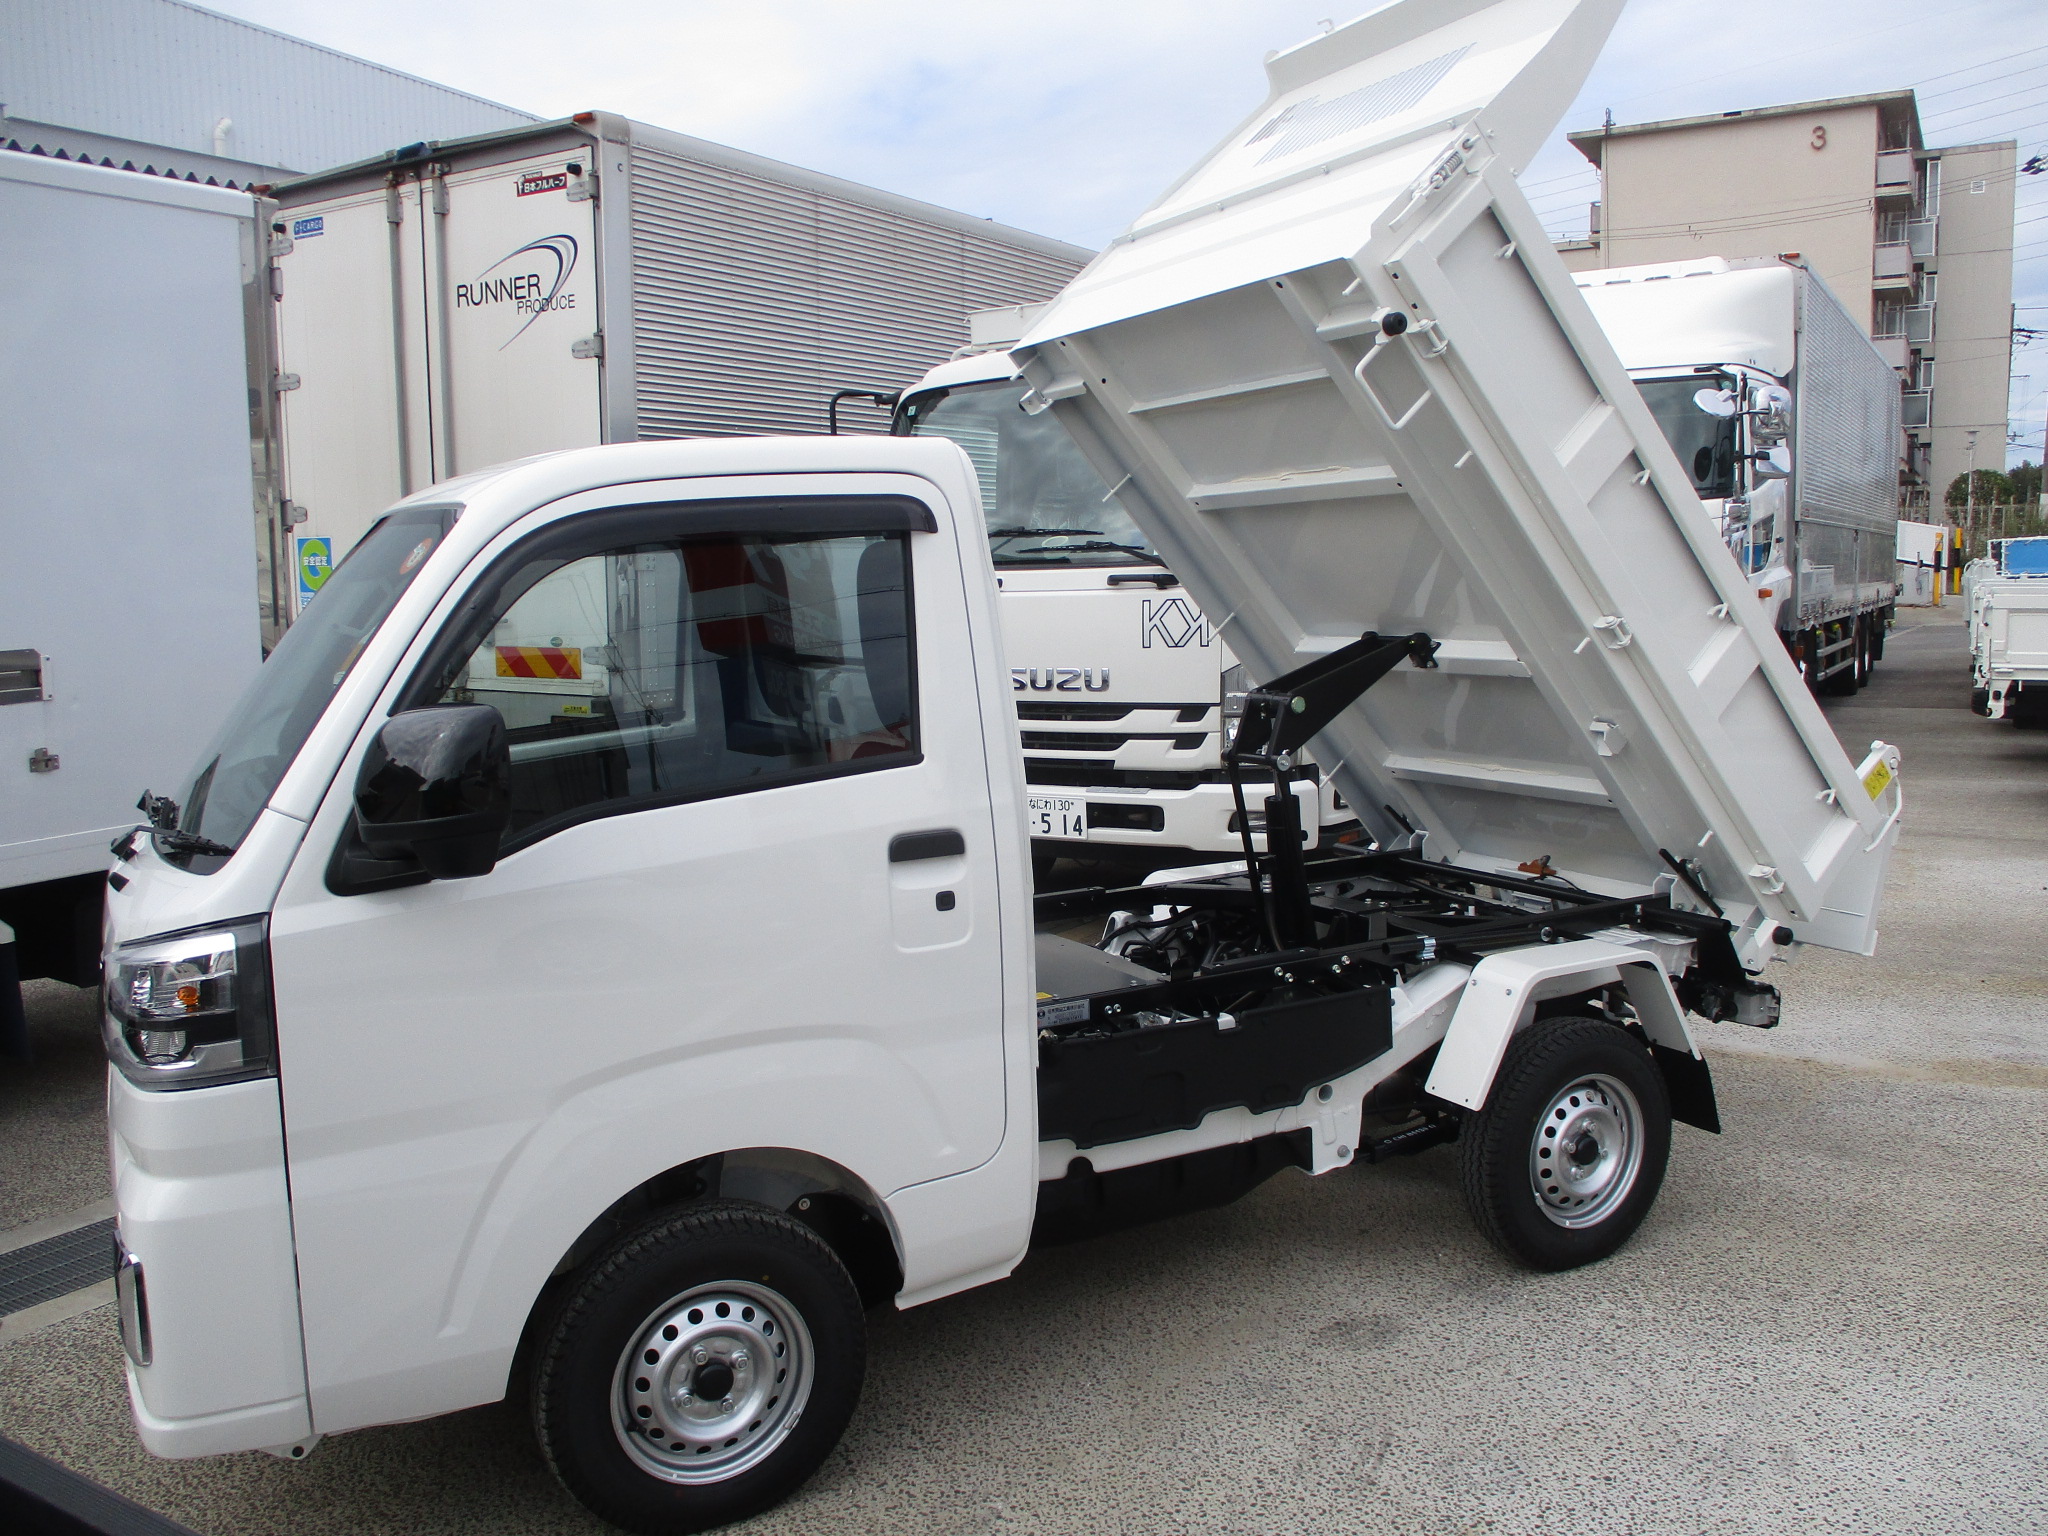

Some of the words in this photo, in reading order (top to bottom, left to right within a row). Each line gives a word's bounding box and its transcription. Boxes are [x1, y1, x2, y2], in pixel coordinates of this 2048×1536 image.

[1811, 126, 1826, 151] 3
[524, 176, 566, 193] 日本フルハーフ
[456, 273, 542, 308] RUNNER
[516, 294, 576, 315] PRODUCE
[1011, 667, 1110, 692] SUZU
